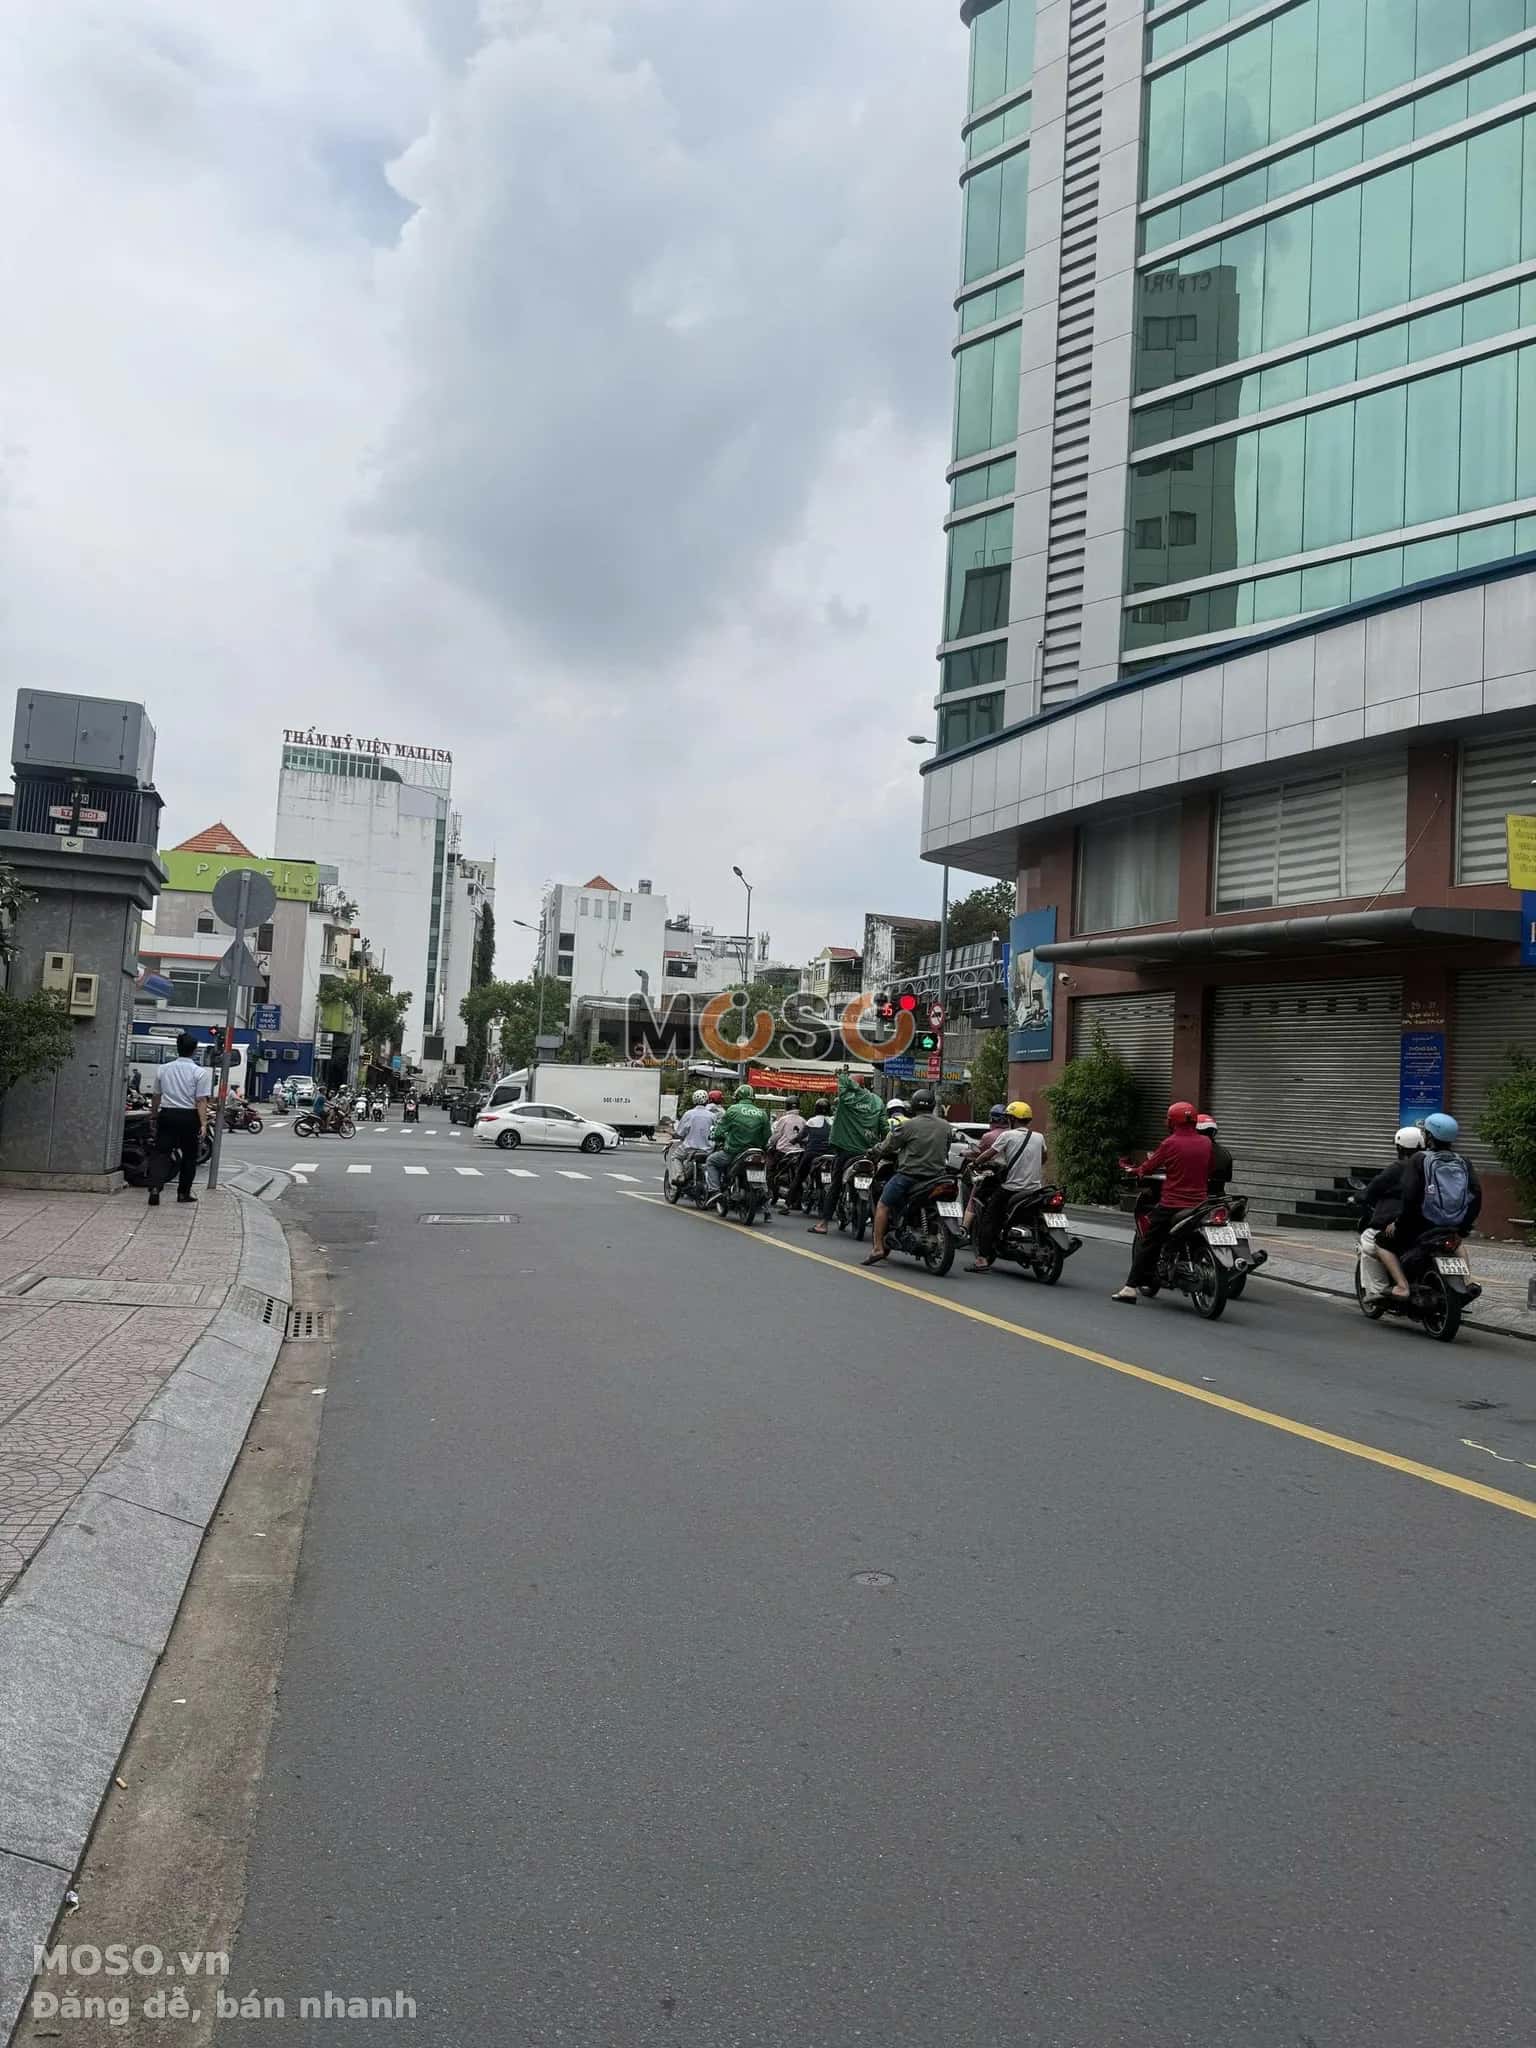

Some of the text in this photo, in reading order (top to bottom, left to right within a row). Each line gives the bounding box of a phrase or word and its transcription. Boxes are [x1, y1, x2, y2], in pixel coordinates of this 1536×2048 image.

[283, 726, 453, 763] THẨM MỸ VIỆN MAILISA
[741, 1107, 763, 1118] Grab
